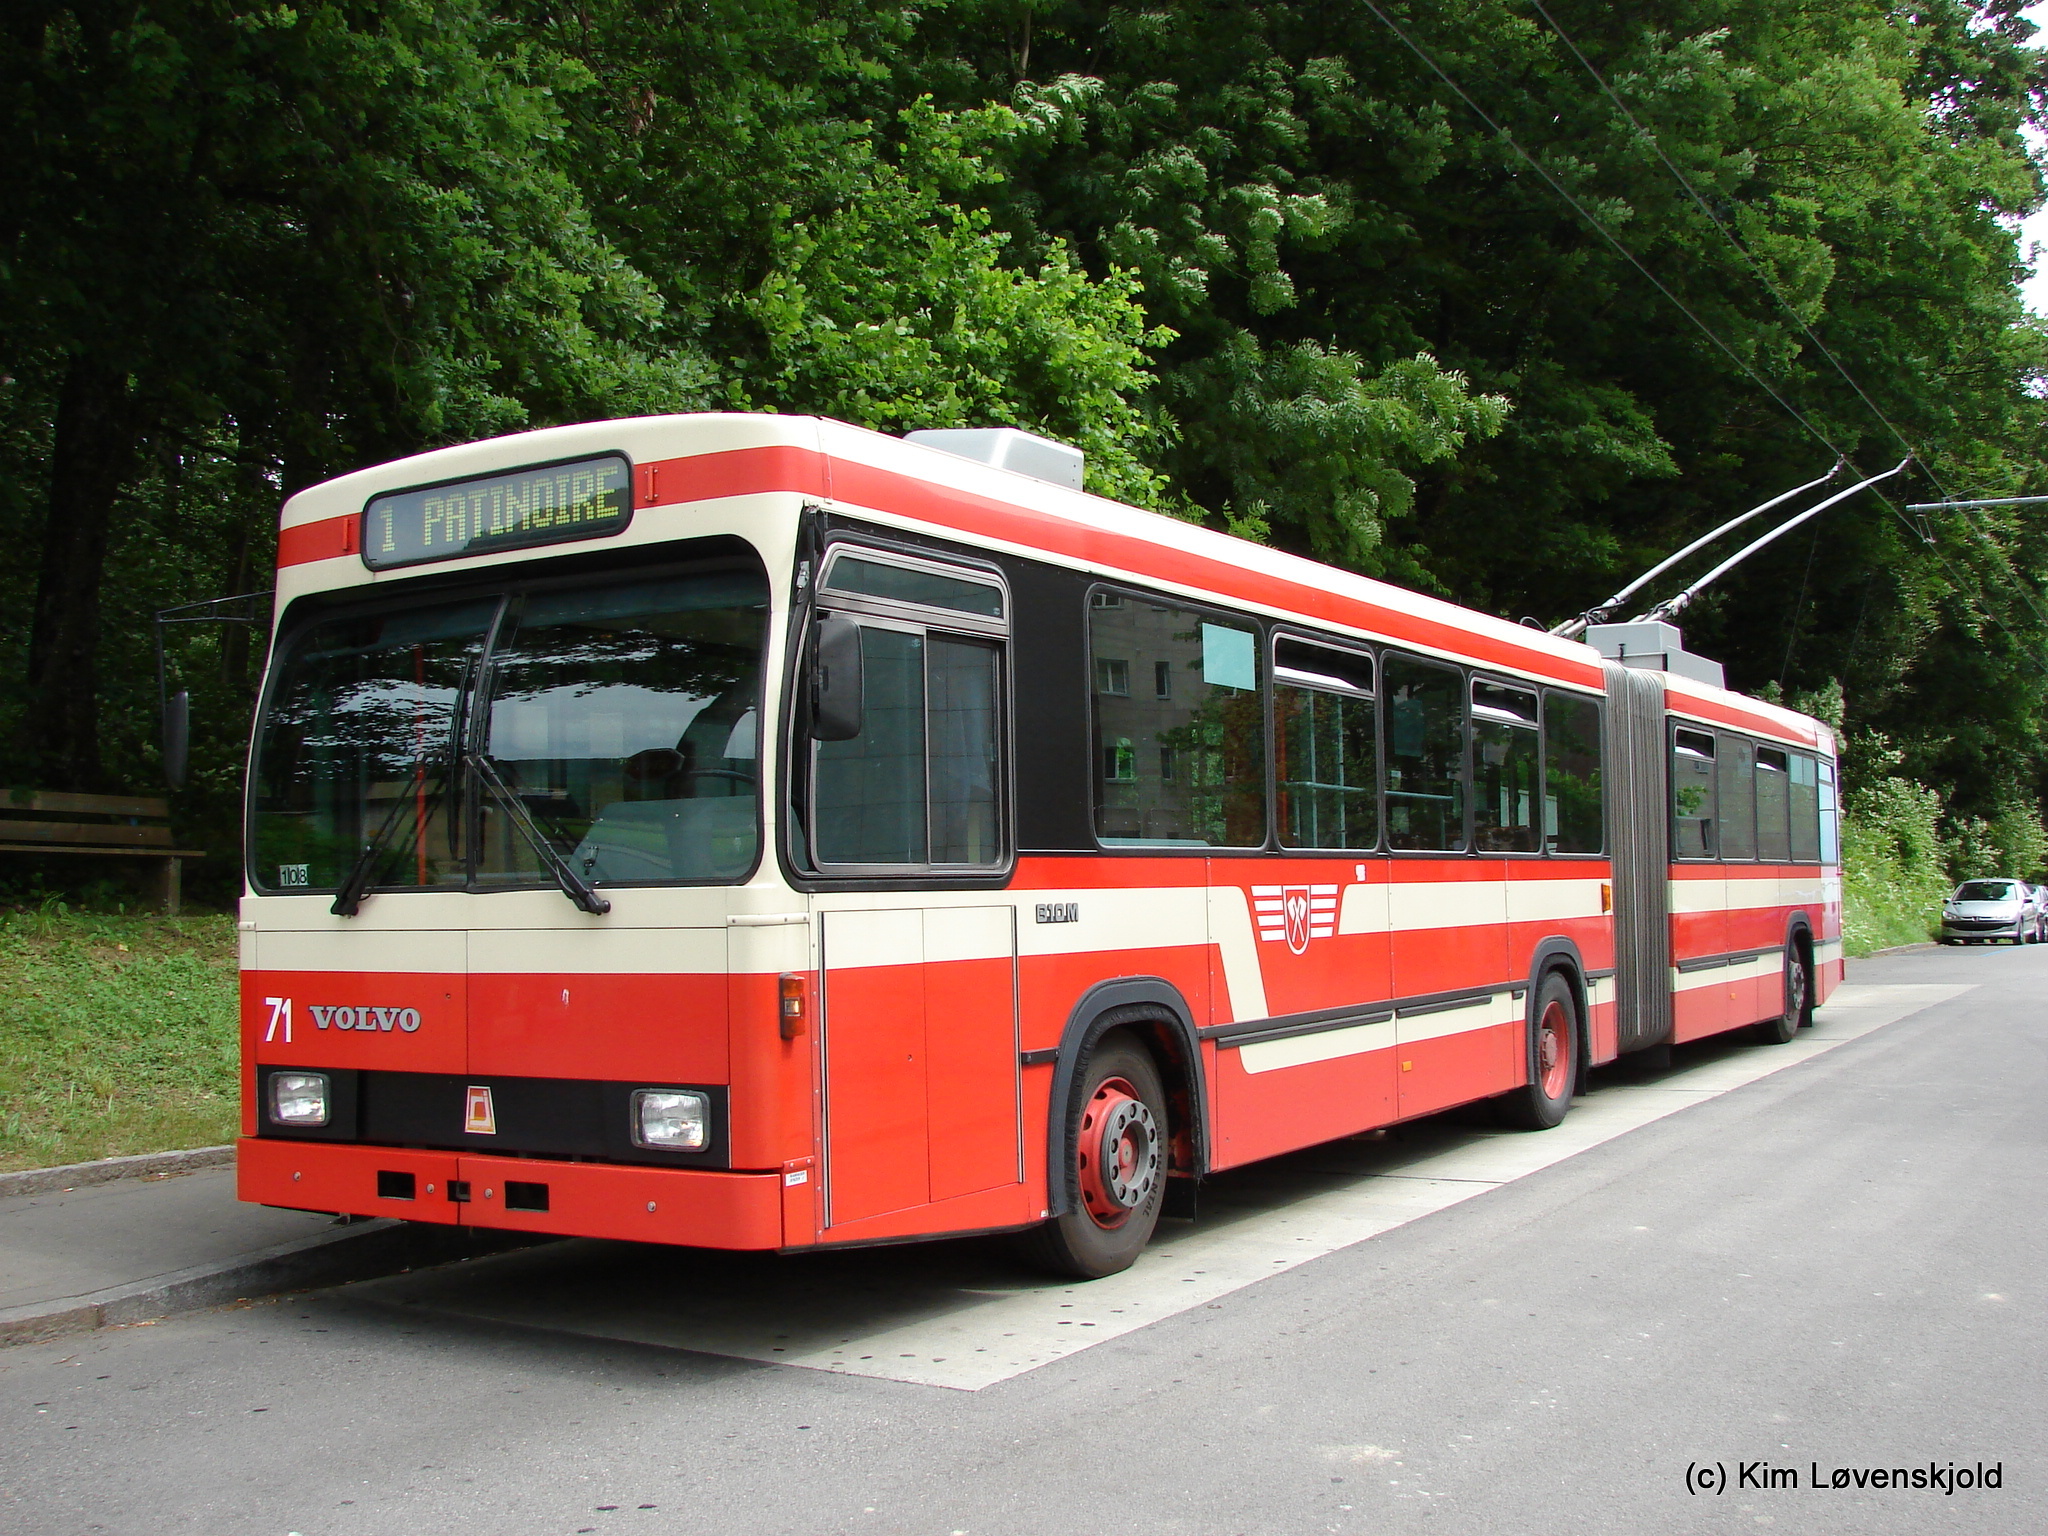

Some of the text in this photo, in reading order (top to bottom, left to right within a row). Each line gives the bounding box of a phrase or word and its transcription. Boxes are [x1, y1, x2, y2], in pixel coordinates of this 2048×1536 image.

[380, 465, 619, 553] 1 PATINOIRE
[281, 867, 308, 885] 108
[1035, 903, 1079, 923] B10M
[265, 997, 292, 1043] 71
[308, 1005, 421, 1033] VOLVO
